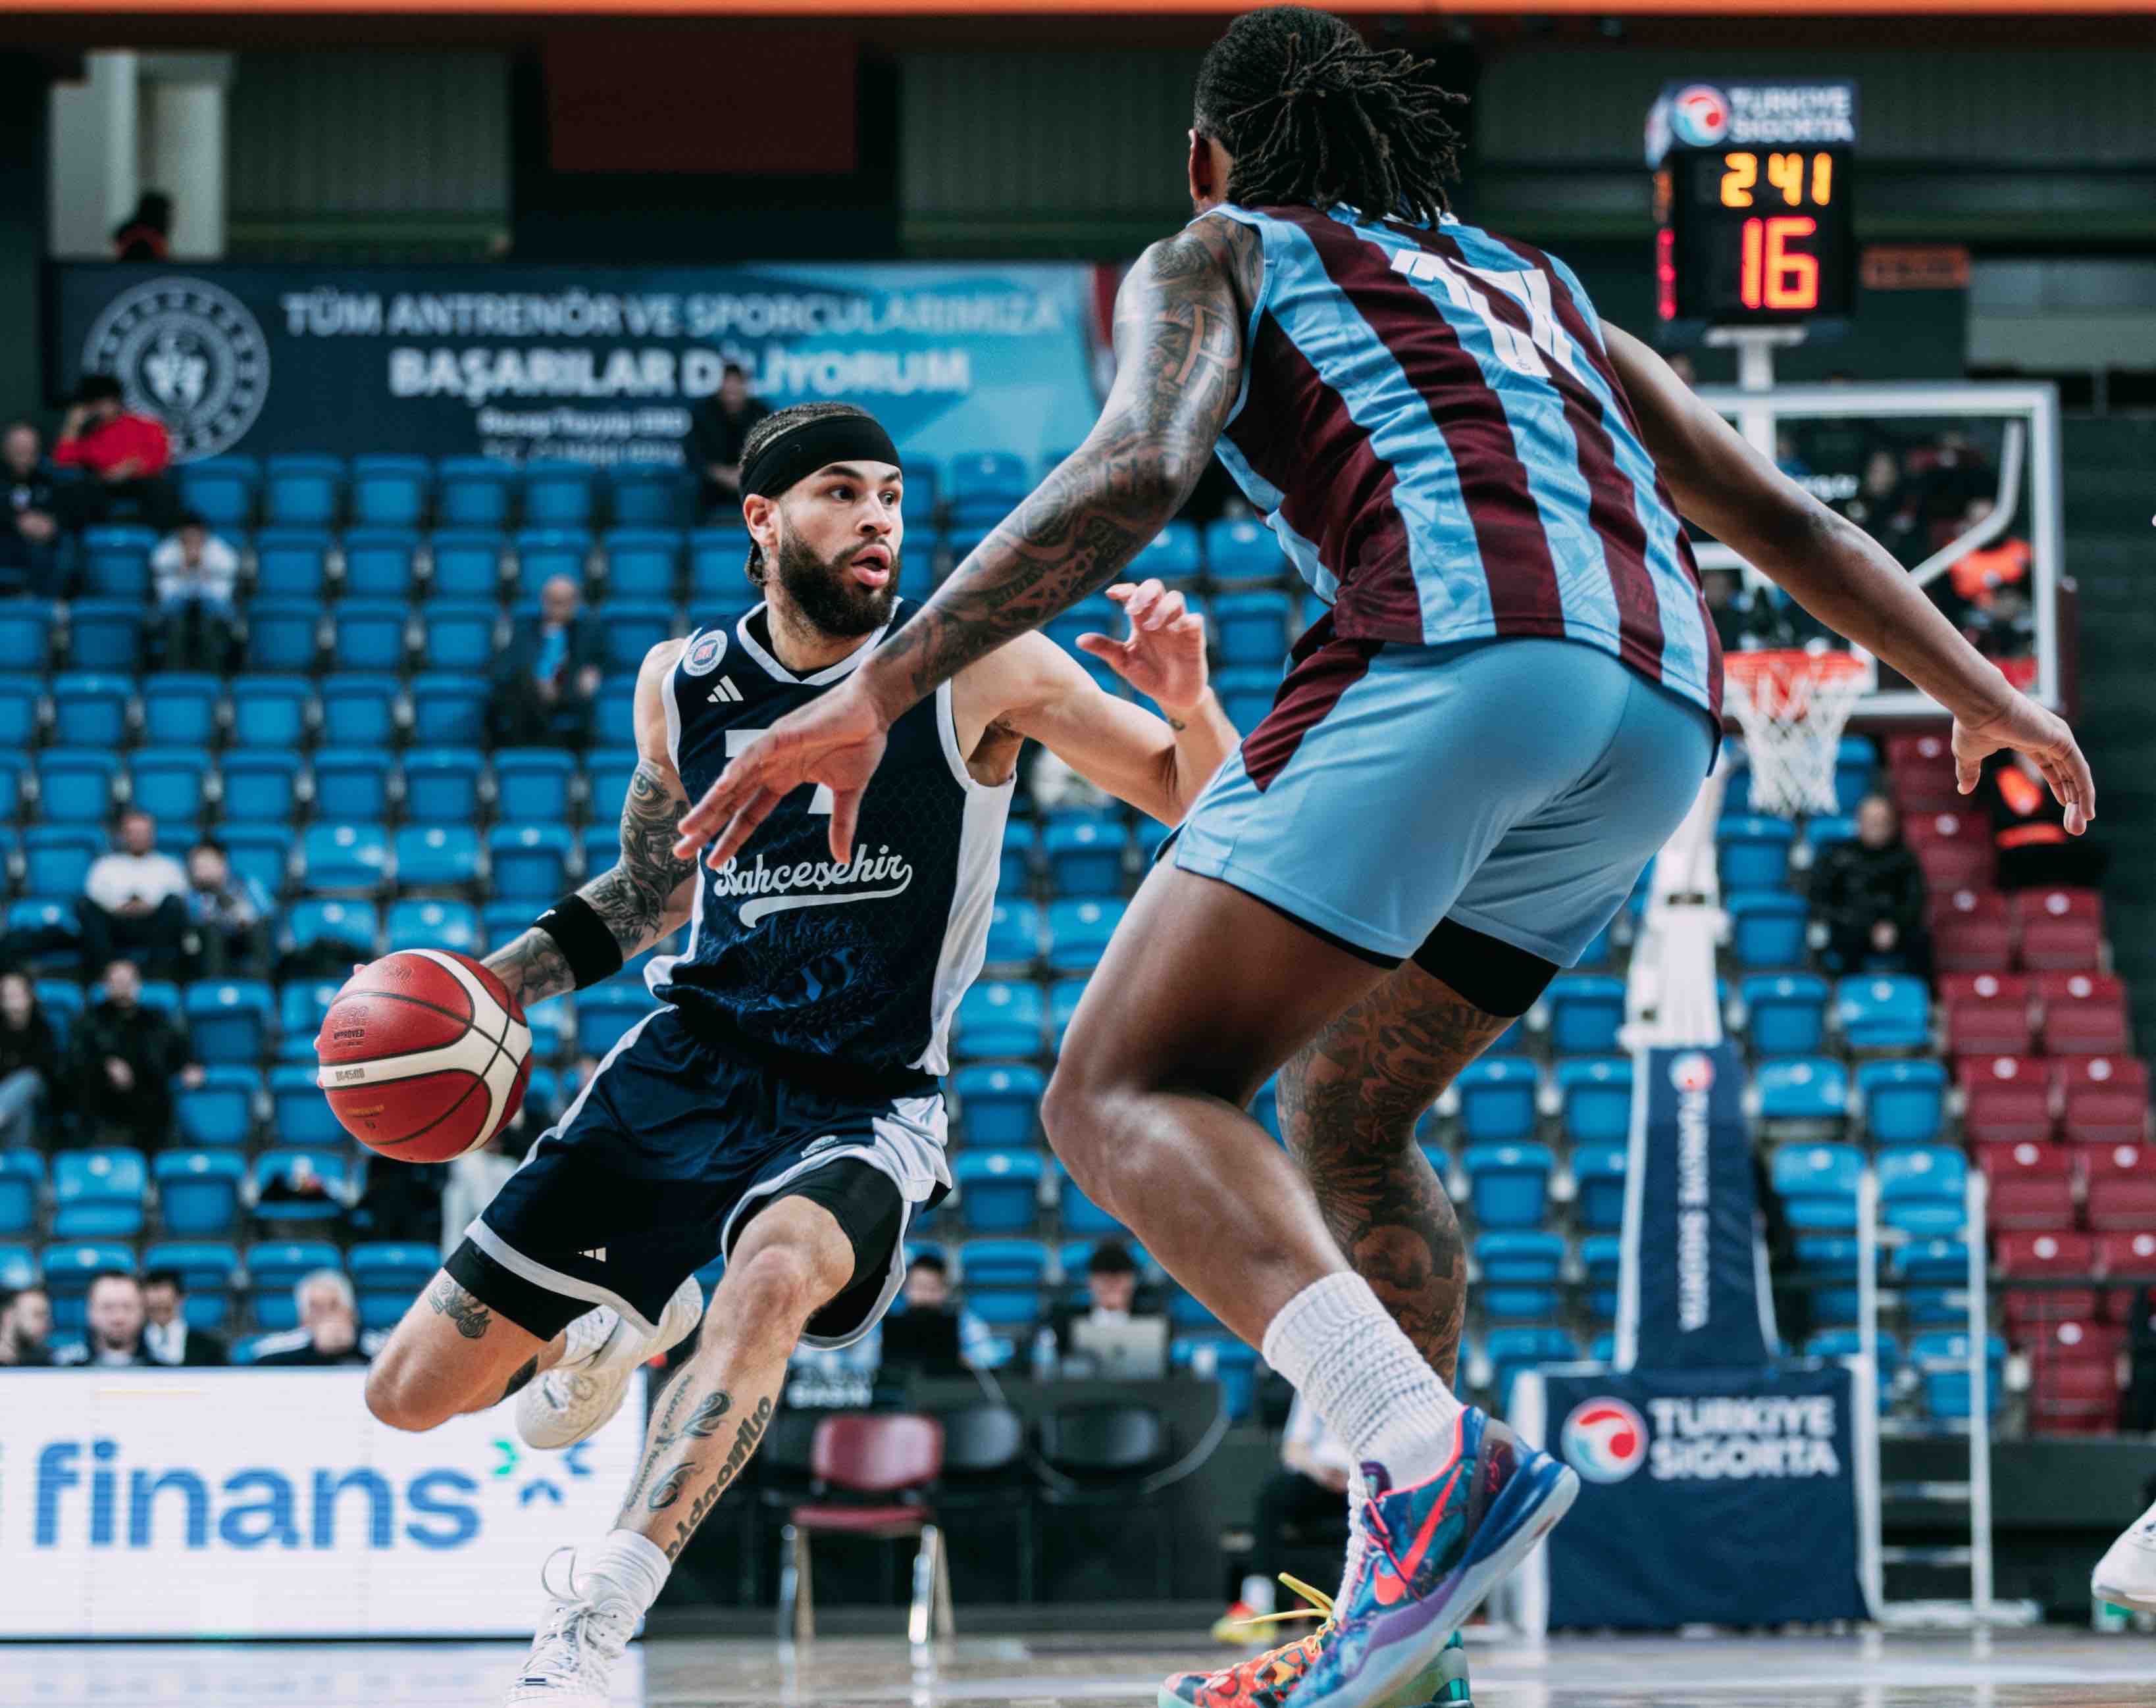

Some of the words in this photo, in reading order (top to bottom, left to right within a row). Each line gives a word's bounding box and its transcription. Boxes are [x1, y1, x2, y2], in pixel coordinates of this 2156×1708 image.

[1740, 216, 1819, 310] 16
[280, 285, 383, 337] TÜM
[621, 292, 680, 338] VE
[388, 346, 678, 407] BAŞARILAR
[713, 843, 913, 896] Bahçeşehir
[33, 1439, 484, 1549] finans
